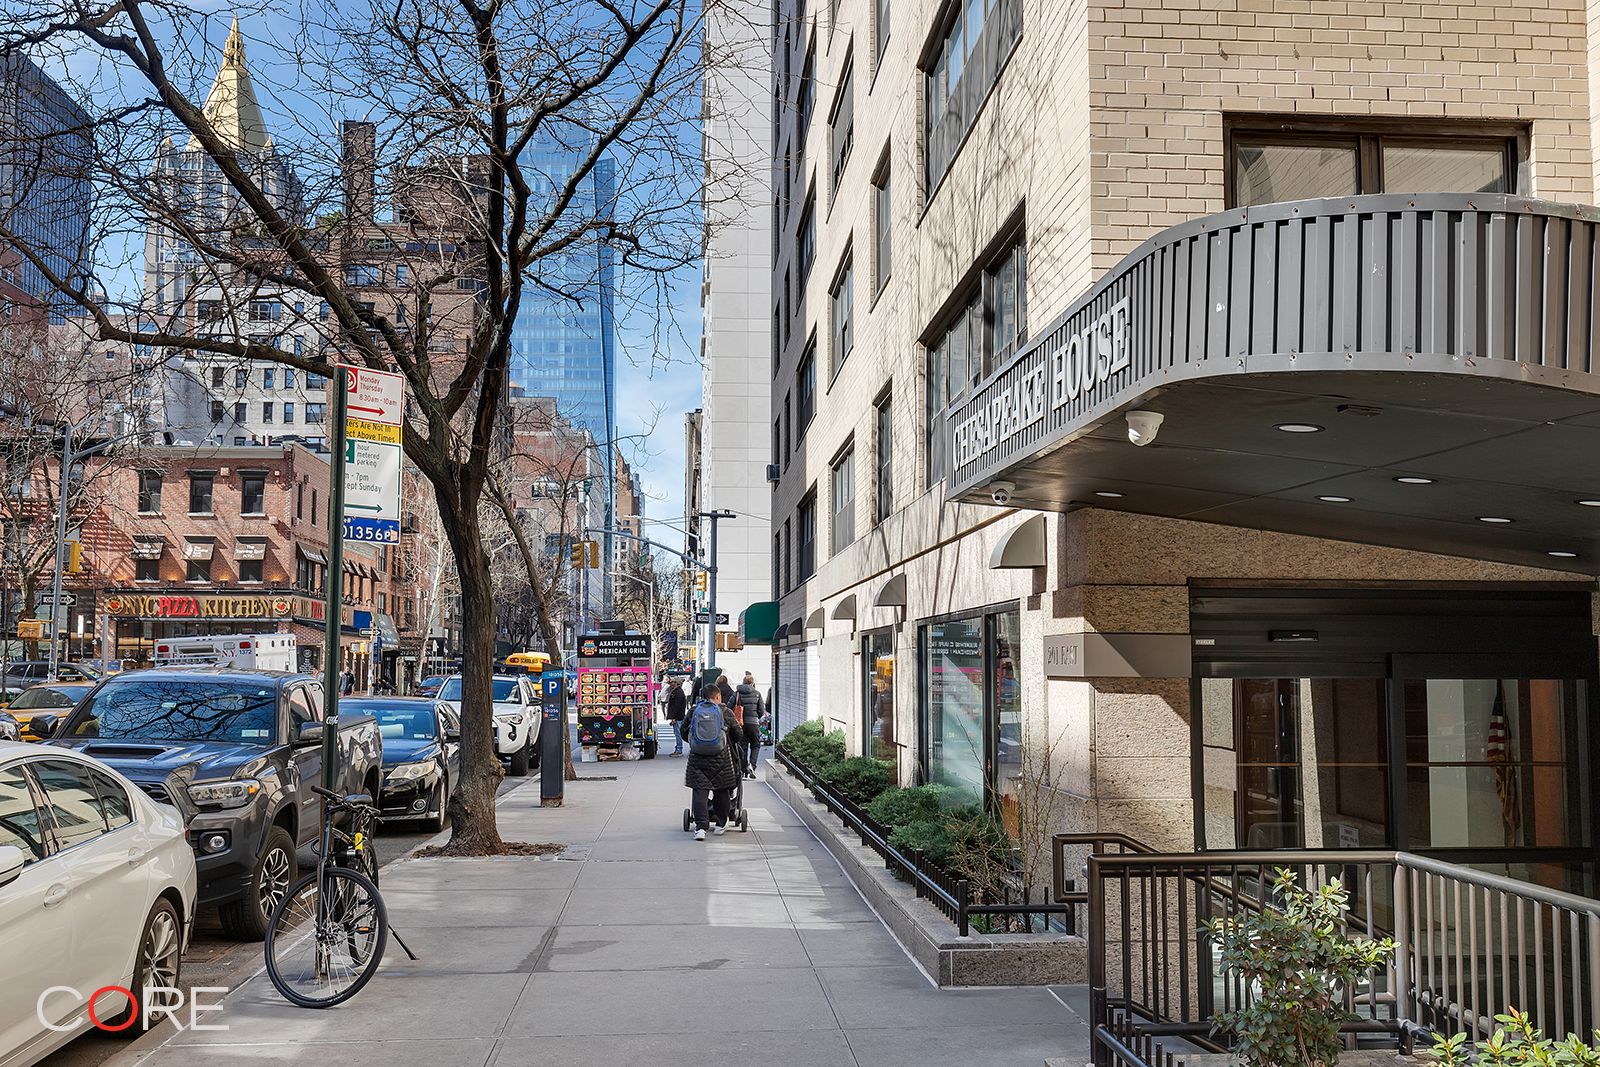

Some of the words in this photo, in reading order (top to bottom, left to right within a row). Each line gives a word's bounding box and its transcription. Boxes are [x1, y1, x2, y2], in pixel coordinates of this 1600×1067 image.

[360, 375, 380, 384] Monday
[953, 360, 1046, 471] CHESAPEAKE
[1052, 295, 1132, 411] HOUSE
[360, 383, 384, 394] Thursday
[359, 394, 379, 403] 8:30am
[384, 398, 397, 406] 10am
[360, 422, 370, 430] Are
[372, 423, 384, 432] Not
[357, 431, 376, 440] Above
[378, 434, 396, 444] Times
[356, 460, 378, 468] parking
[356, 472, 369, 482] 7pm
[359, 482, 382, 494] Sunday
[124, 596, 156, 615] NYC
[158, 596, 200, 616] PIZZA
[202, 596, 271, 616] KITCHEN
[1048, 646, 1059, 665] 201
[1061, 646, 1078, 665] EAST
